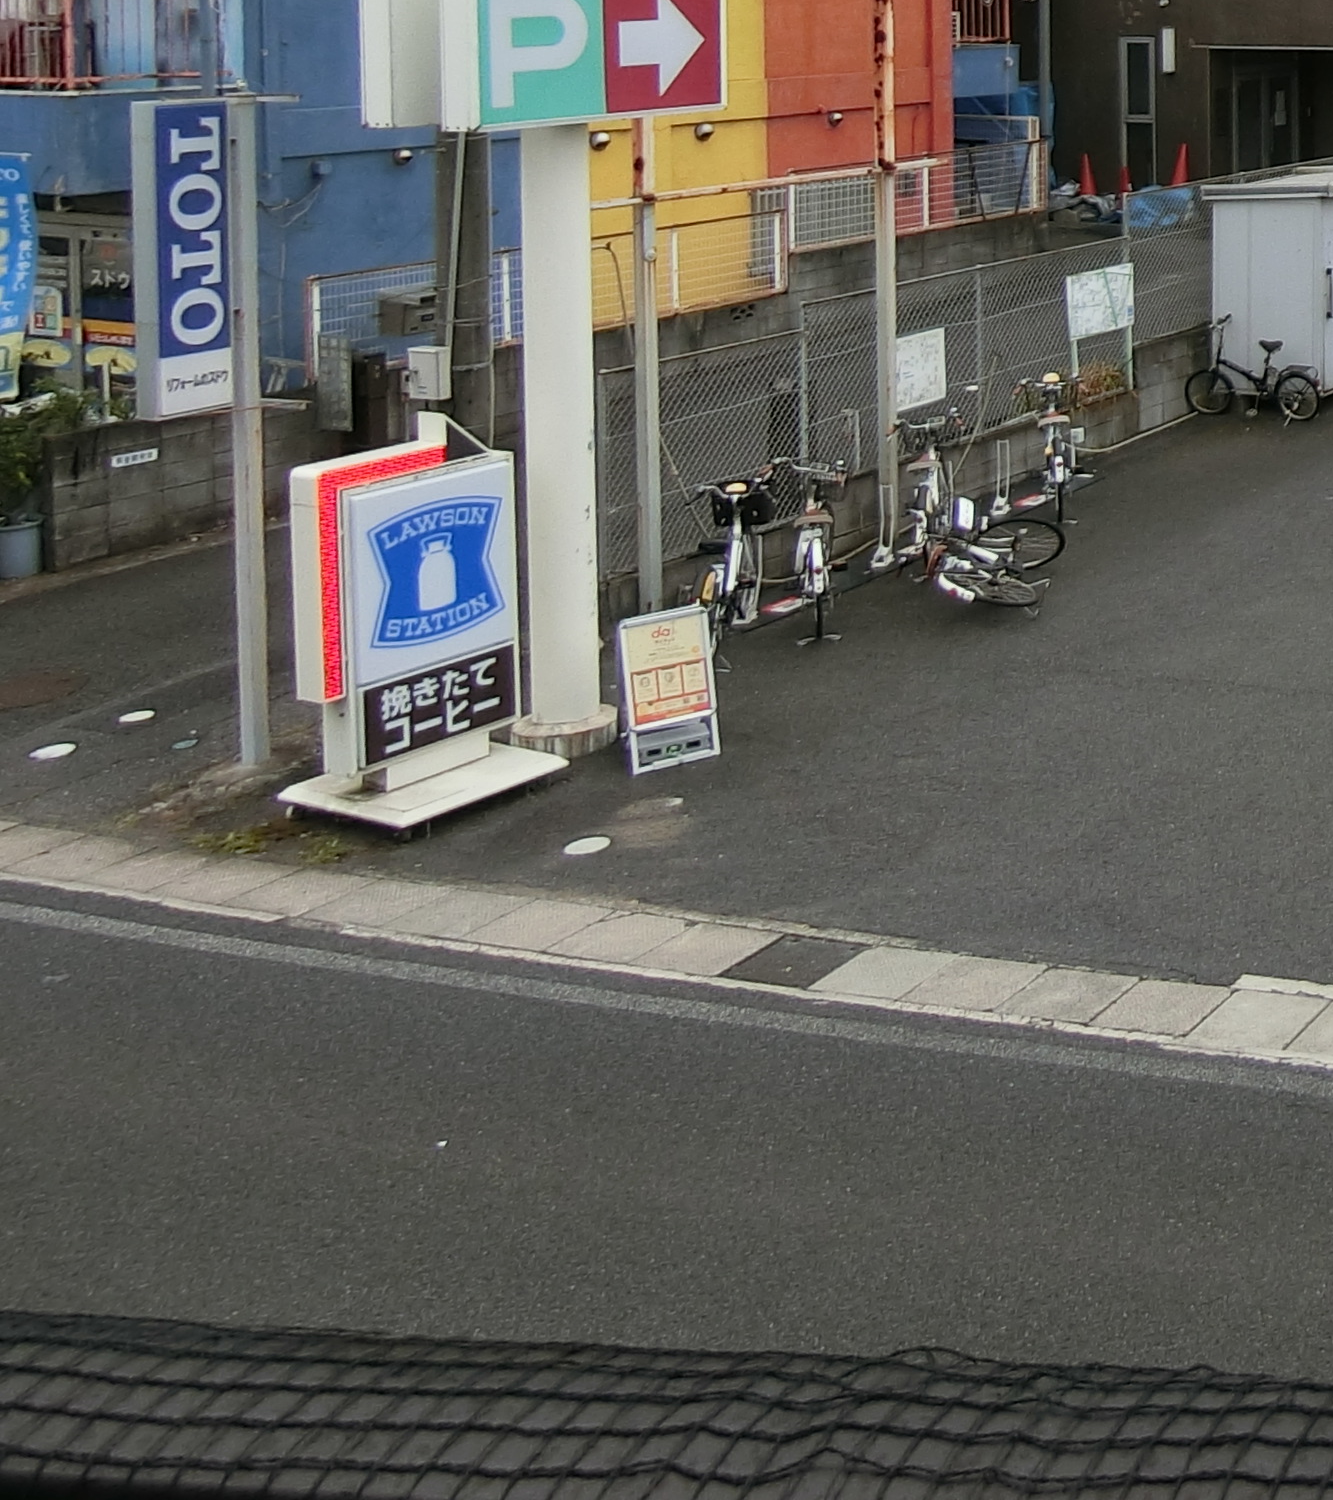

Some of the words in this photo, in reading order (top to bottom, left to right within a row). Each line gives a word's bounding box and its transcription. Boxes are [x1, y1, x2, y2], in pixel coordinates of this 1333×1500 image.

[169, 116, 225, 346] TOTO
[90, 268, 130, 290] スドウ
[380, 506, 489, 550] LAWSON
[385, 592, 490, 638] STATION
[381, 656, 497, 721] 挽きたて
[384, 696, 501, 754] コーヒー
